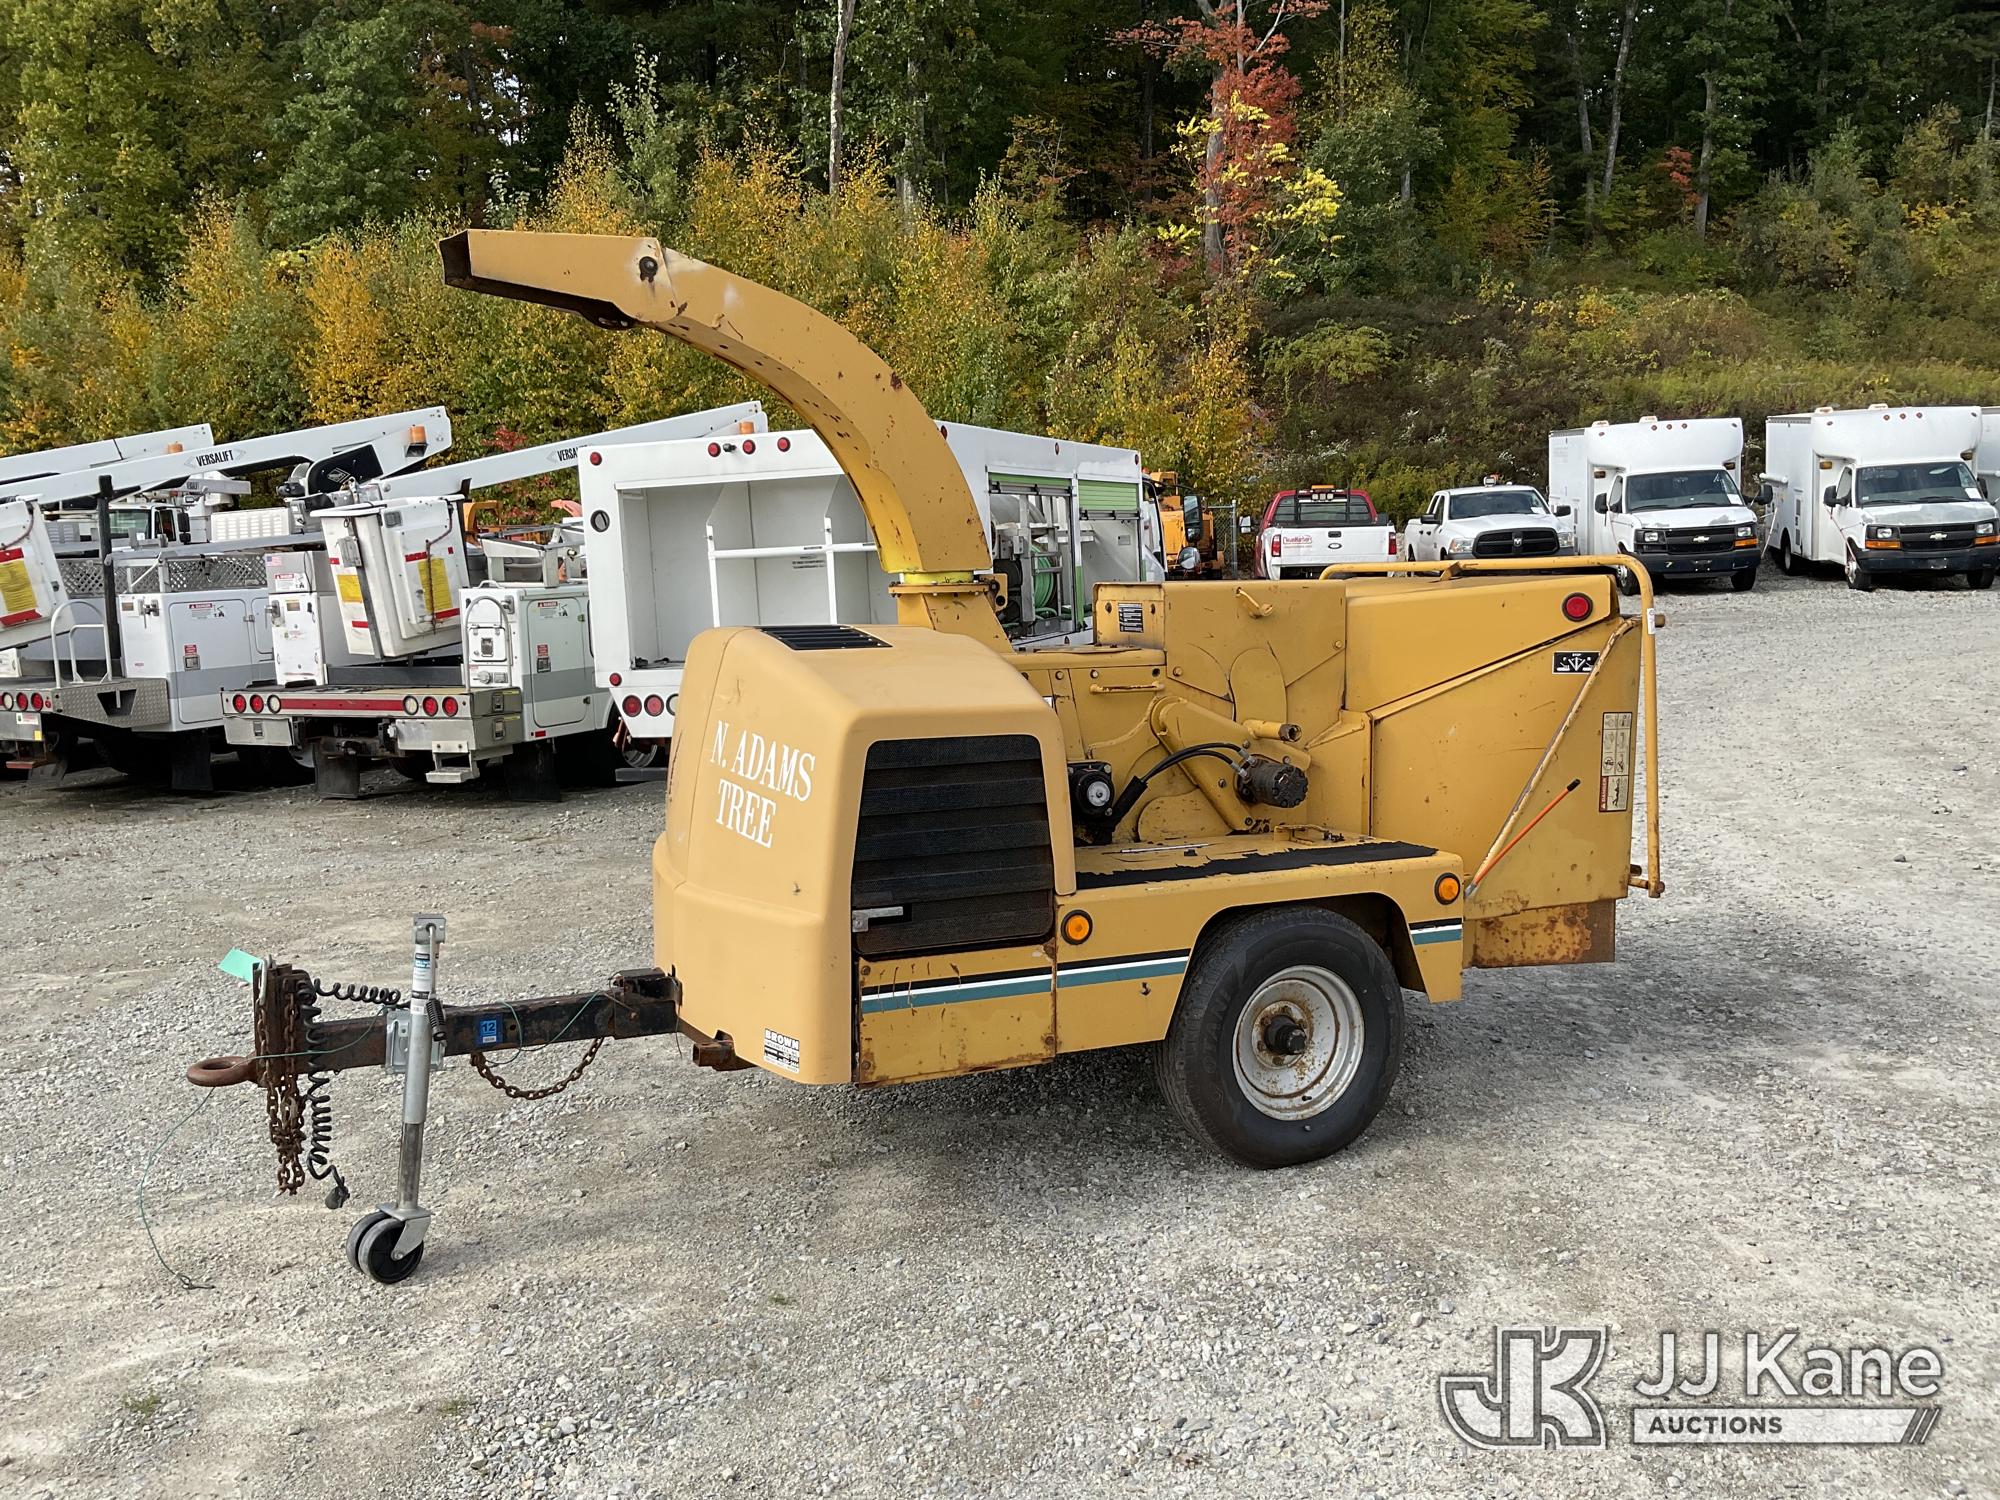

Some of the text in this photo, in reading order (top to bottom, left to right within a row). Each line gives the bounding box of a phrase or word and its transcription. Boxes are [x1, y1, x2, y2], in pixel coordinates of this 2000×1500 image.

[196, 450, 234, 467] VERSALIFT
[557, 445, 580, 461] VERSA
[710, 719, 816, 802] N. ADAMS
[715, 777, 777, 849] TREE
[483, 1022, 495, 1032] 12
[764, 1028, 800, 1052] BROWN
